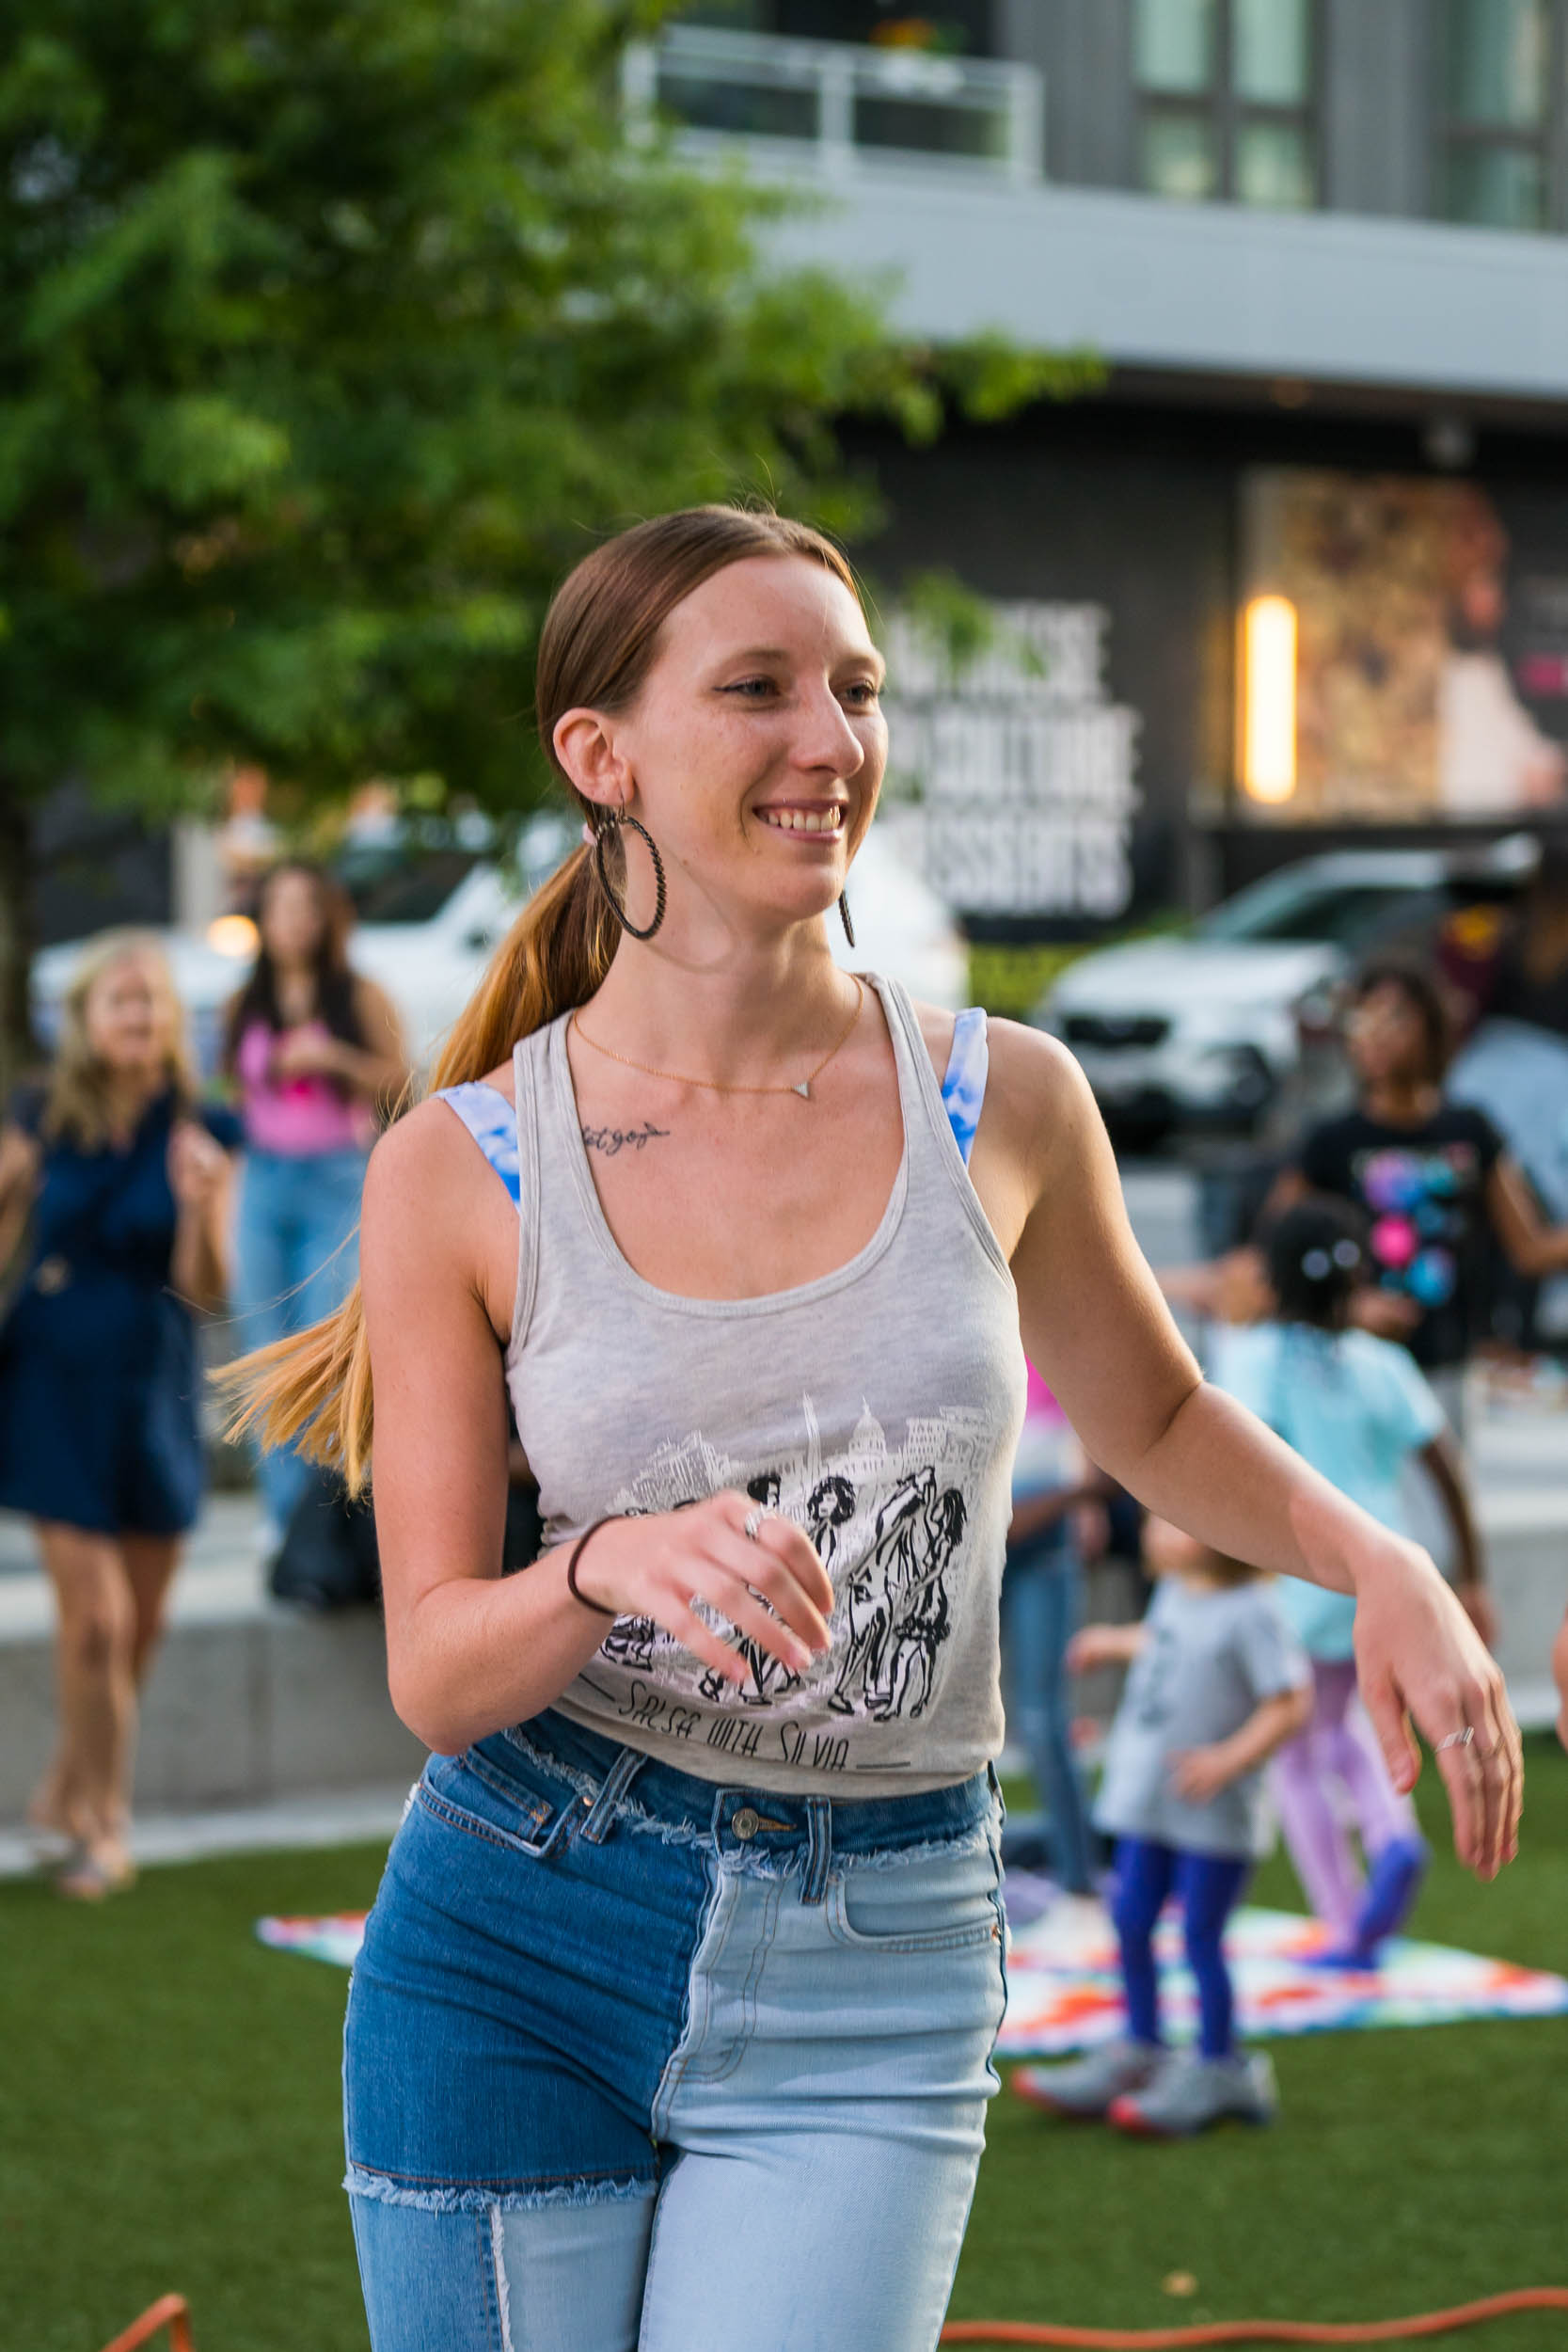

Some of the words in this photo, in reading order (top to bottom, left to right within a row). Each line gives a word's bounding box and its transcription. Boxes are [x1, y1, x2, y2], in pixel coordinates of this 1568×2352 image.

[619, 1679, 702, 1740] SALSA
[707, 1718, 765, 1757] WITH
[780, 1720, 849, 1772] SILVIA
